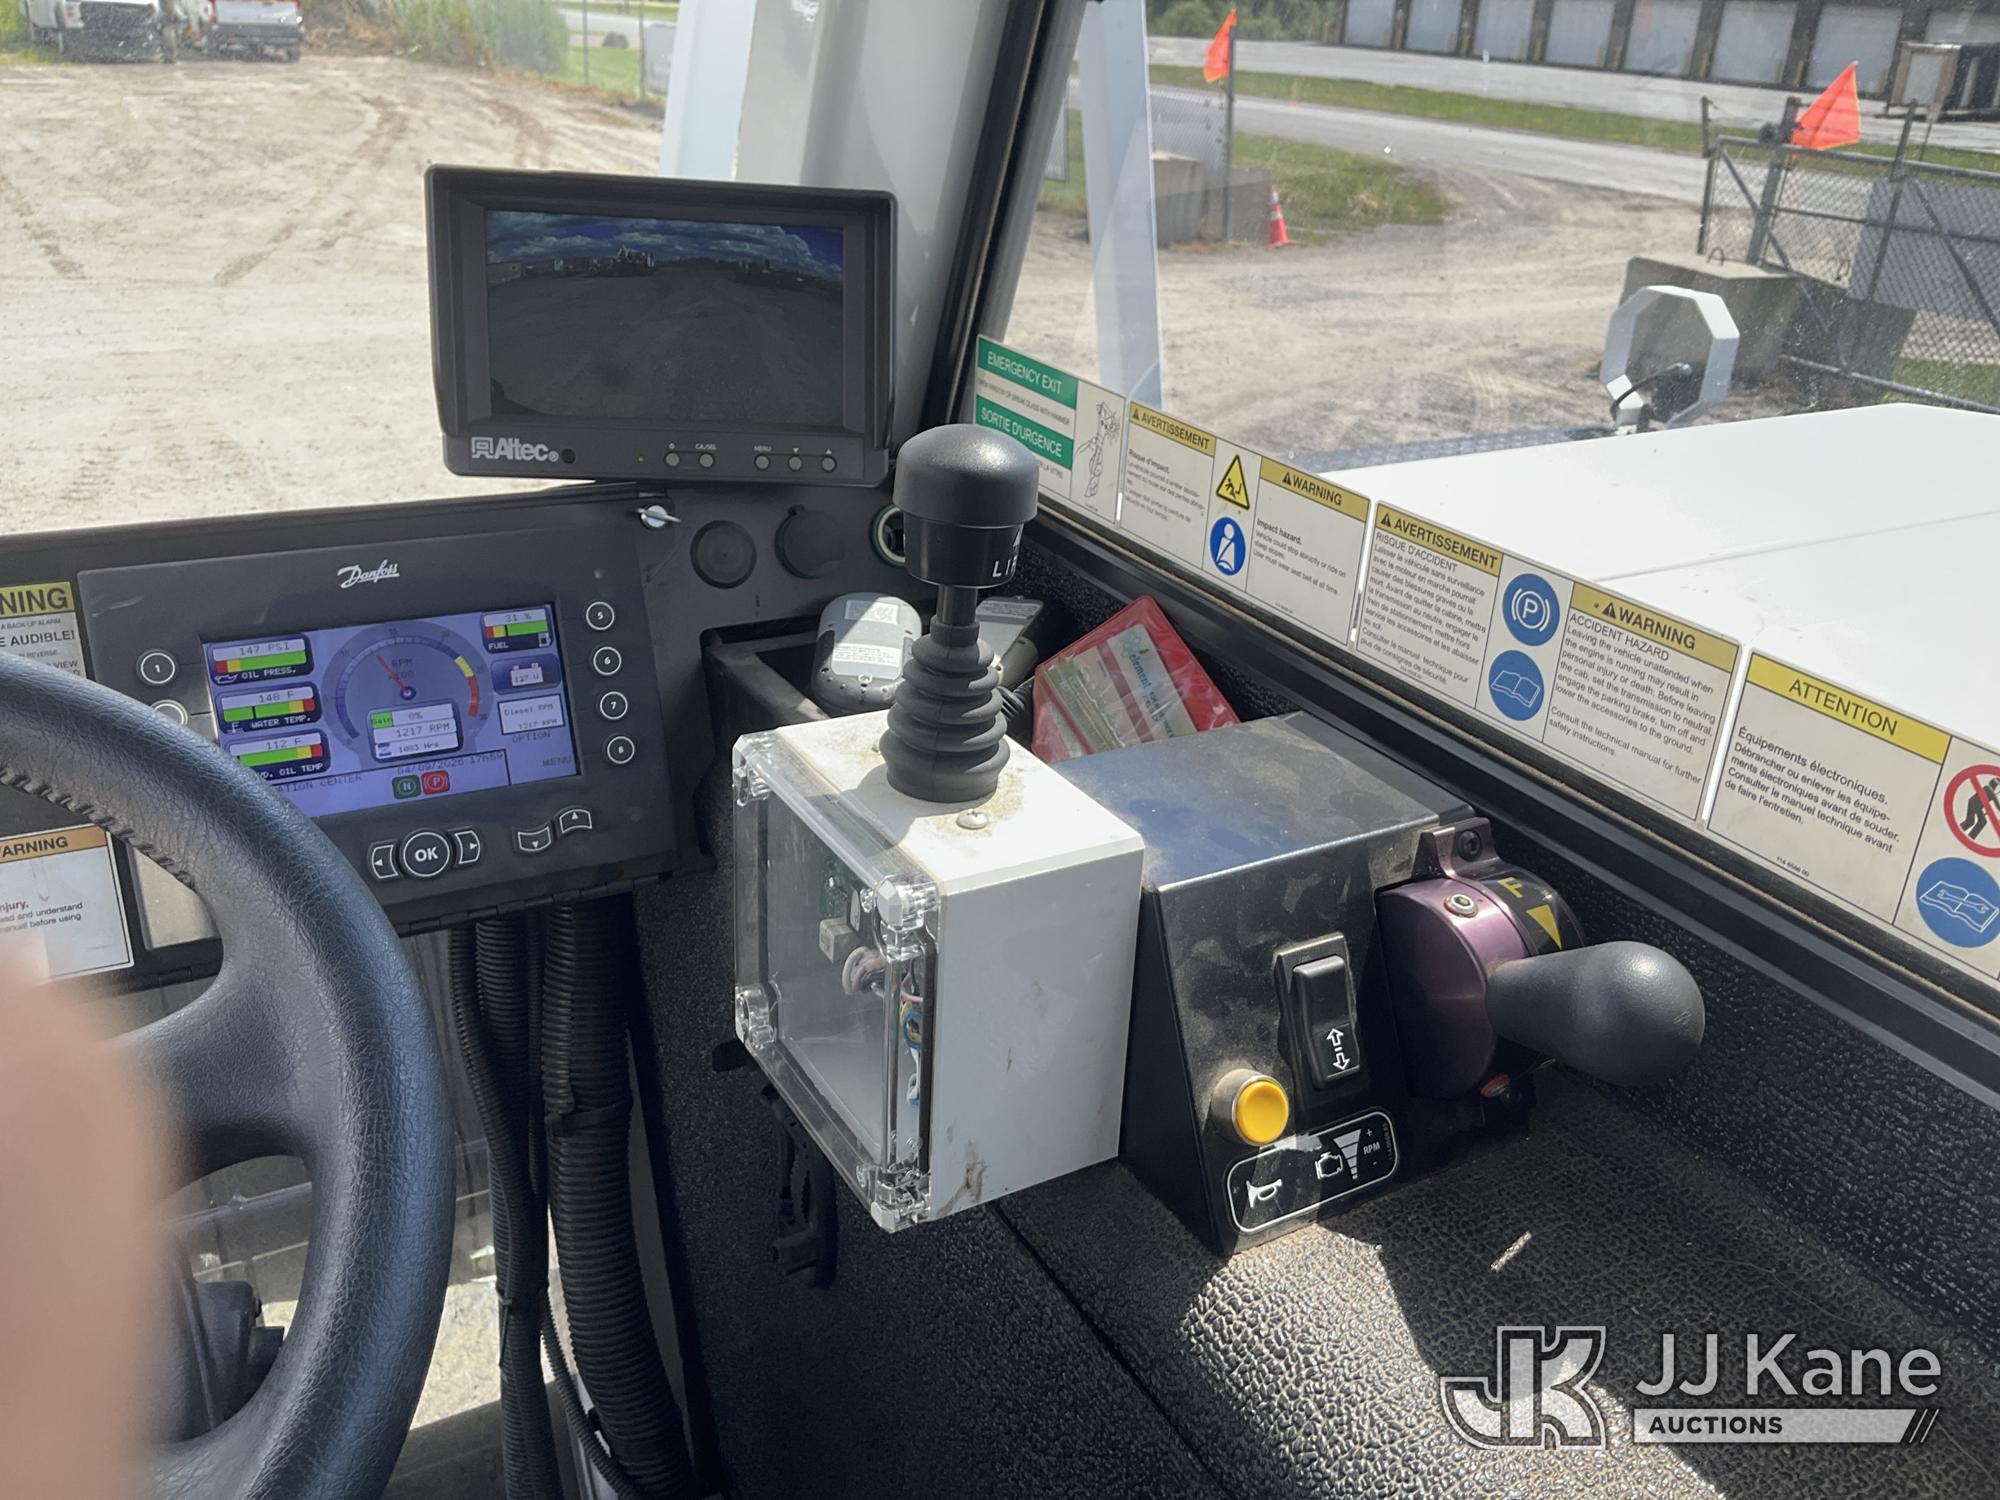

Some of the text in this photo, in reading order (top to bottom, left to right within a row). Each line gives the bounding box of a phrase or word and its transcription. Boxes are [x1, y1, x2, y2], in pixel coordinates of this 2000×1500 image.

[987, 350, 1061, 395] EMERGENCY EXIT
[981, 406, 1062, 457] SORTIE D'URGENCE
[1141, 411, 1209, 450] AVERTISSEMENT
[494, 437, 549, 460] Altec
[1292, 475, 1342, 506] WARNING
[1257, 517, 1277, 534] Impact
[1376, 531, 1457, 573] RISQUE D'ACCIDENT
[1393, 516, 1497, 570] AVERTISSEMENT
[337, 560, 399, 588] Danfoss
[0, 588, 67, 614] NING
[598, 611, 604, 620] 5
[11, 630, 75, 646] AUDIBLE!
[1569, 611, 1669, 662] ACCIDENT HAZARD
[1617, 606, 1697, 650] WARNING
[238, 641, 290, 656] 147 PSI
[488, 642, 510, 650] FUEL
[154, 664, 160, 673] 1
[604, 656, 611, 665] 6
[1564, 637, 1699, 702] the engine is running may result in
[1566, 625, 1713, 695] Leaving the vehicle unattended when
[241, 666, 296, 679] OIL PRESS.
[1560, 660, 1572, 672] the
[1592, 675, 1604, 687] set
[1606, 681, 1619, 693] the
[1620, 688, 1671, 717] transmission
[1672, 711, 1681, 722] to
[1561, 648, 1595, 671] personal
[1595, 663, 1618, 682] injury
[1619, 675, 1628, 684] or
[1657, 690, 1684, 709] Before
[1685, 703, 1716, 725] leaving
[258, 692, 281, 703] 148
[611, 701, 617, 709] 7
[1788, 676, 1898, 736] ATTENTION
[504, 706, 533, 716] Diesel
[1555, 683, 1575, 698] lower
[1577, 693, 1589, 705] the
[1591, 700, 1637, 728] accessories
[1639, 722, 1647, 732] to
[1648, 727, 1661, 739] the
[1557, 673, 1585, 693] engage
[1587, 685, 1600, 697] the
[1601, 692, 1630, 713] parking
[1659, 719, 1676, 732] turn
[1677, 727, 1688, 738] off
[1689, 733, 1705, 746] and
[250, 714, 311, 728] WATER TEMP.
[396, 723, 450, 737] 1217 RPM
[1548, 717, 1571, 735] safety
[265, 739, 288, 749] 112
[512, 733, 550, 743] OPTION
[1550, 705, 1701, 785] Consult the technical manual for further
[618, 745, 624, 754] 8
[278, 763, 323, 776] OIL TEMP
[542, 756, 573, 767] MENU
[1737, 724, 1889, 807] Équipements électroniques.
[1734, 742, 1891, 824] Débrancher ou enlever les équipe-
[1724, 778, 1804, 824] de faire l'entretien.
[1730, 754, 1900, 842] ments électroniques avant de souder.
[1727, 766, 1892, 853] Consulter le manuel technique avant
[0, 836, 68, 857] ARNING
[414, 846, 439, 863] OK
[0, 900, 29, 911] njury.
[36, 902, 83, 917] understand
[30, 917, 57, 928] before
[58, 913, 82, 922] using
[1363, 1142, 1381, 1155] RPM
